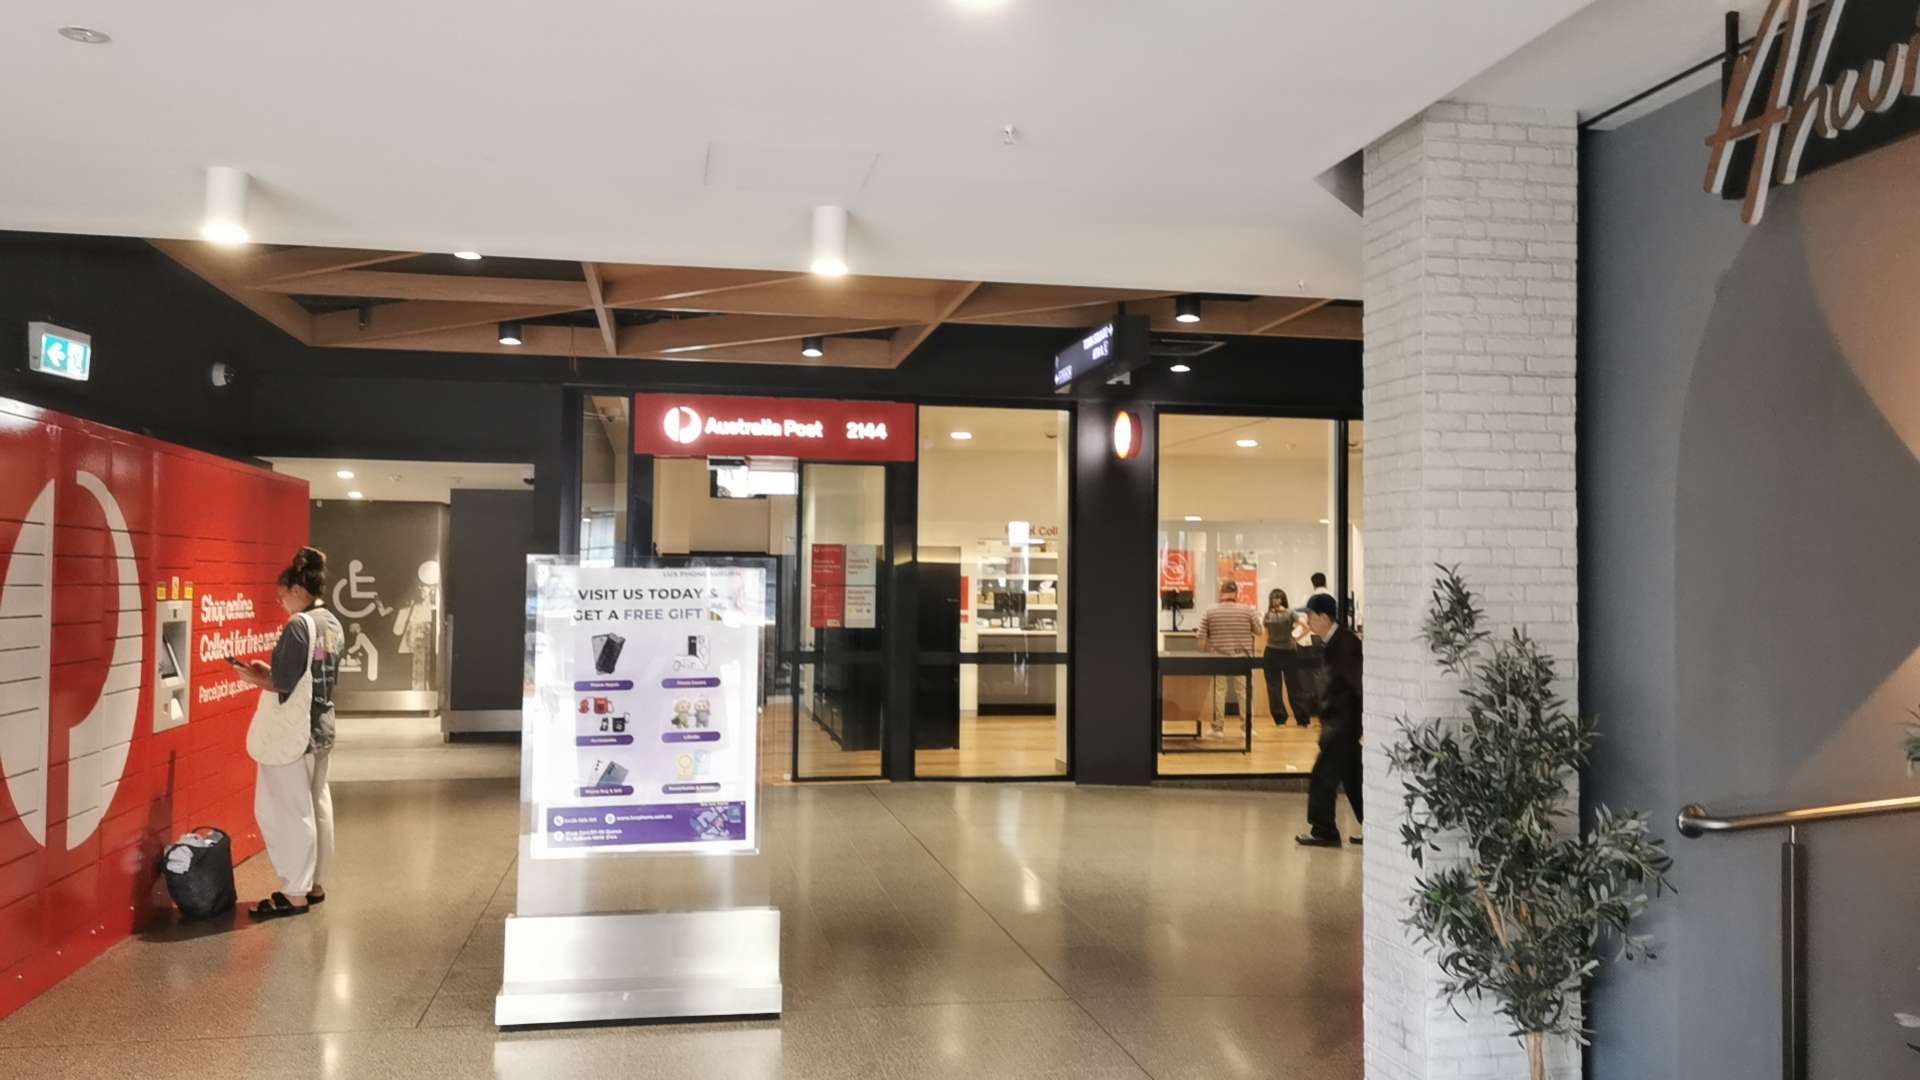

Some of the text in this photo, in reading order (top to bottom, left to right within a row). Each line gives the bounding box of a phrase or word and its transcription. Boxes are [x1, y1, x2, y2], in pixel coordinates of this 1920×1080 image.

[704, 417, 888, 440] Australia Post 2144
[578, 588, 618, 600] VISIT
[623, 588, 644, 599] US
[648, 587, 703, 599] TODAY
[201, 593, 226, 627] Shop
[573, 608, 703, 621] GET A FREE GIFT
[200, 631, 235, 662] Collect
[235, 630, 247, 657] for
